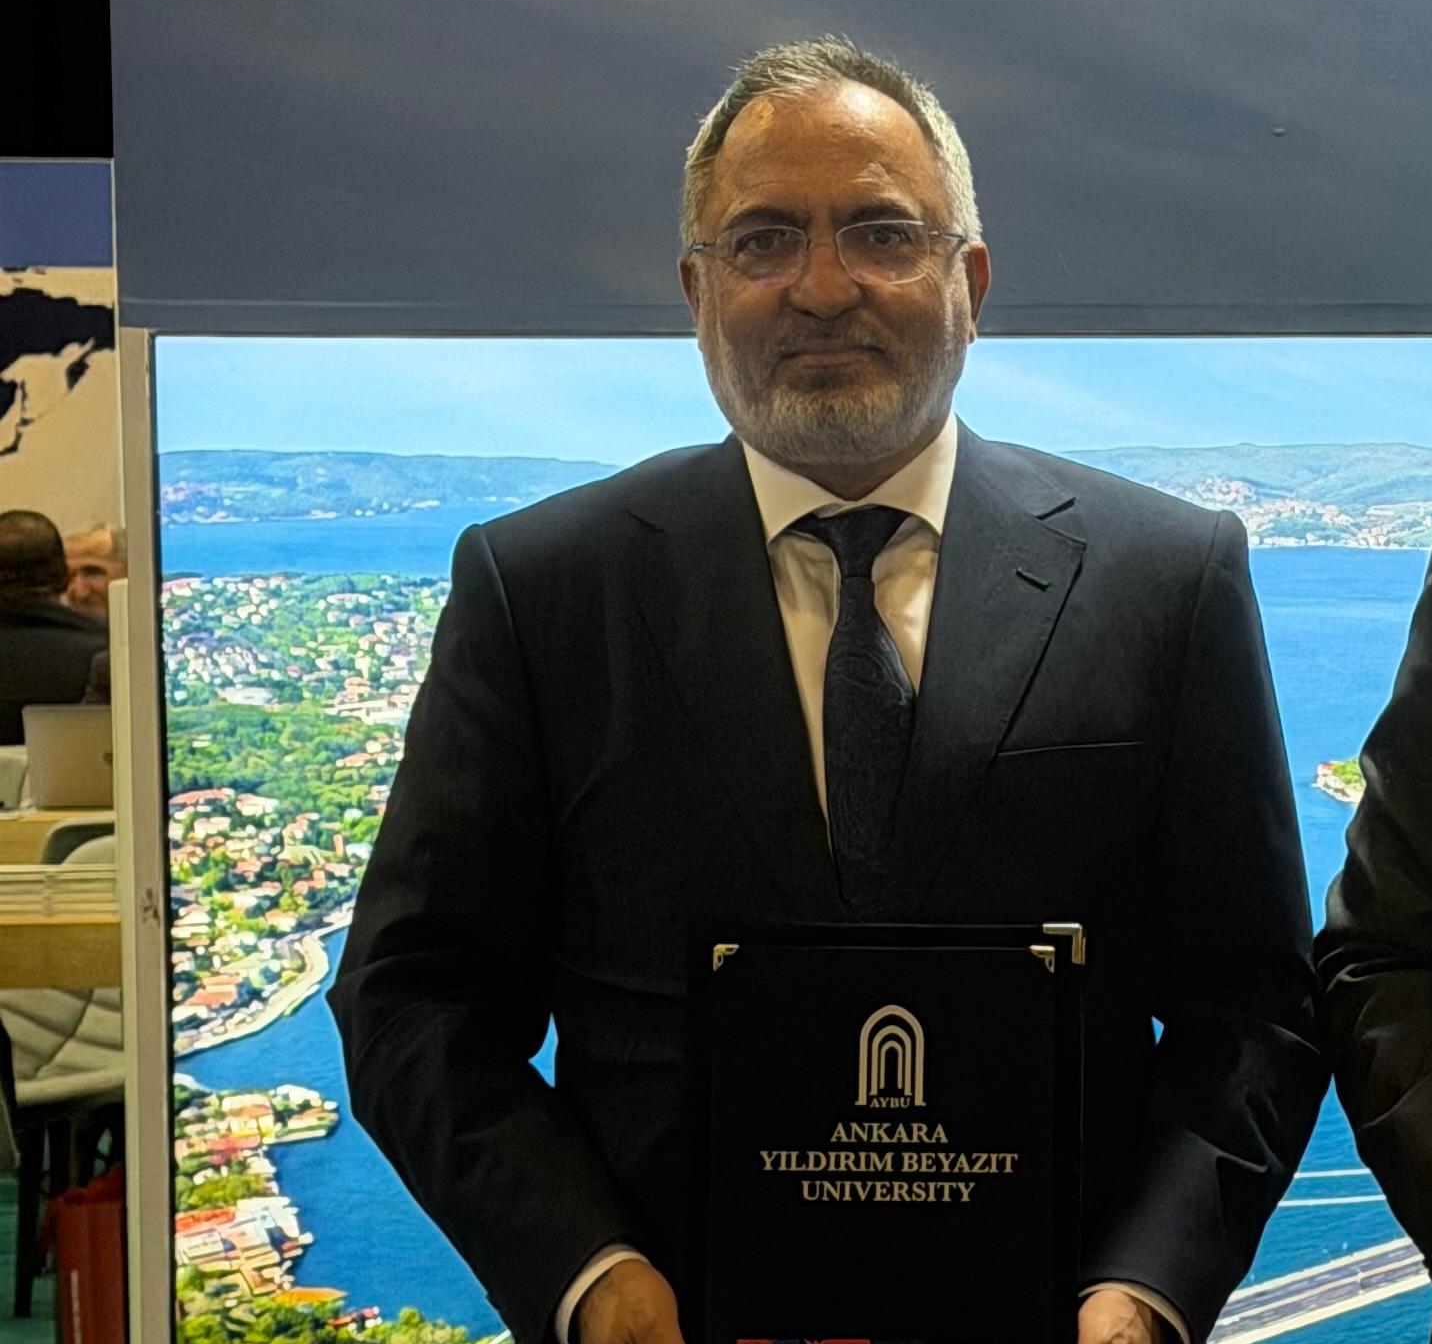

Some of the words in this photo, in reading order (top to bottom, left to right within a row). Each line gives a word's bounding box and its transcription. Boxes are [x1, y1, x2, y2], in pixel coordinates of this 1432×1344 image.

[830, 1122, 949, 1143] ANKARA
[760, 1150, 894, 1172] YILDIRIM
[901, 1152, 1018, 1173] BEYAZIT
[801, 1180, 976, 1202] UNIVERSITY
